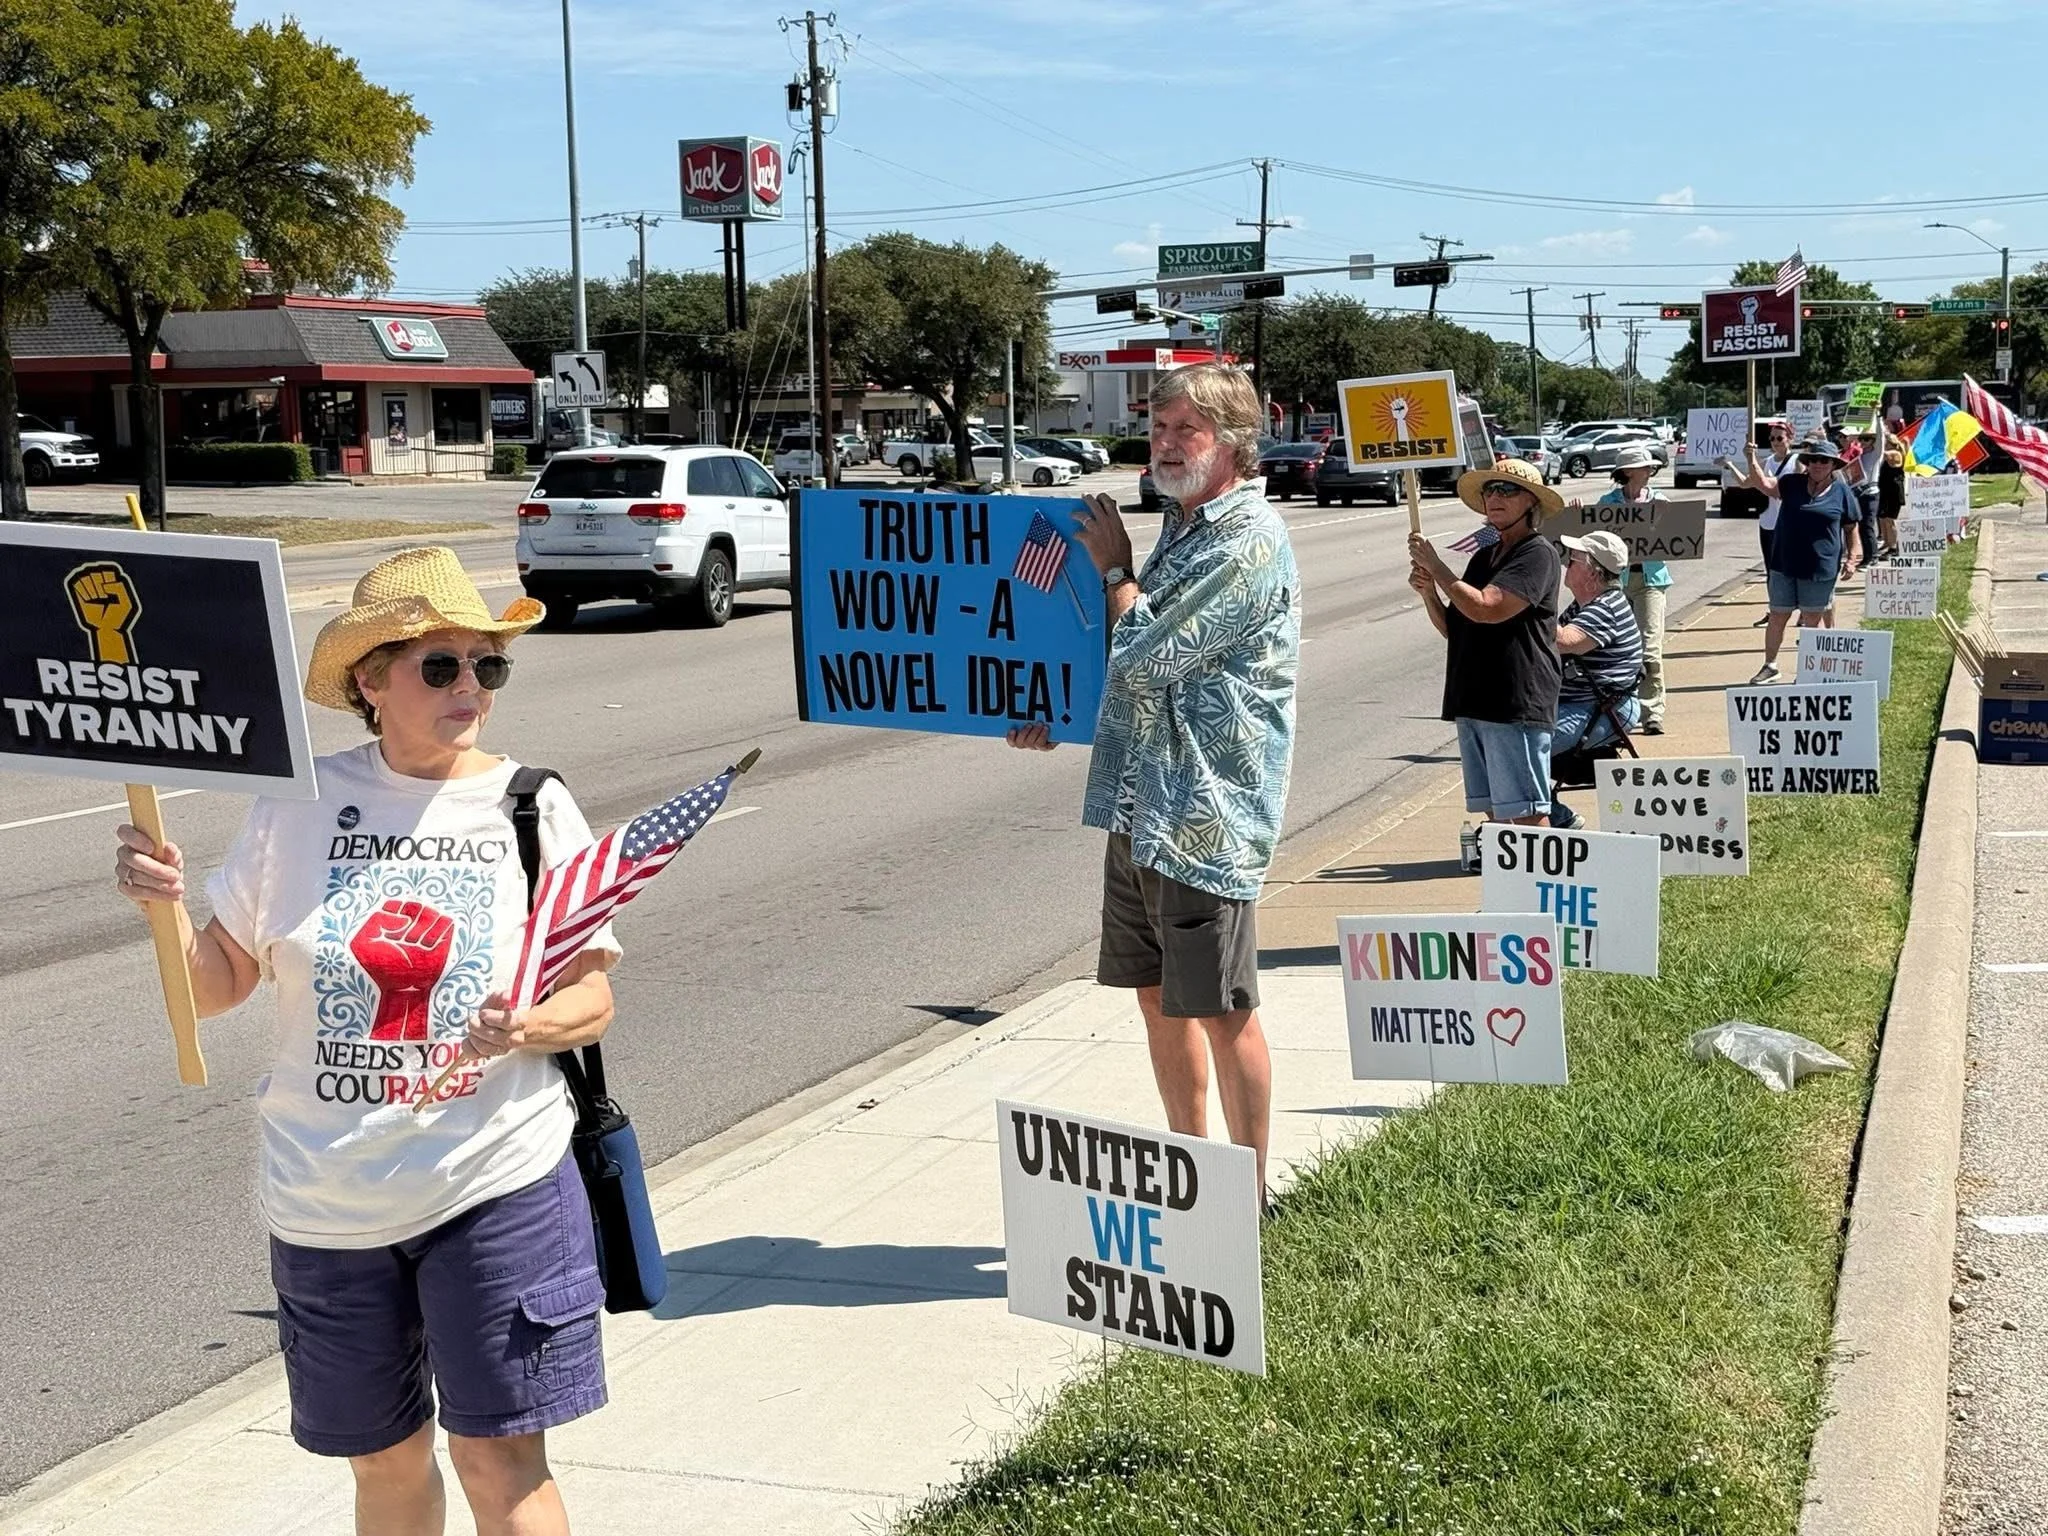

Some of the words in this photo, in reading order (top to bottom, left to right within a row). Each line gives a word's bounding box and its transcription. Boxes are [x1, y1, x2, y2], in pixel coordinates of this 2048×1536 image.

[685, 151, 743, 194] Jack
[753, 151, 783, 195] Jack
[689, 205, 700, 214] in
[701, 204, 720, 213] the
[721, 203, 742, 213] box
[1164, 245, 1253, 264] SPROUTS
[1939, 301, 1980, 309] Abrams
[1712, 335, 1789, 352] FASCISM
[1724, 323, 1777, 337] RESIST
[1059, 353, 1101, 369] Exxon
[490, 400, 526, 414] ROTHERS
[558, 395, 578, 404] ONLY
[583, 394, 603, 403] ONLY
[1707, 412, 1729, 433] NO
[1360, 438, 1447, 460] RESIST
[1695, 438, 1737, 457] KINGS
[859, 499, 990, 565] TRUTH
[1900, 521, 1917, 537] Say
[1922, 520, 1935, 533] No
[1551, 535, 1704, 559] DCRACY
[1902, 540, 1946, 553] VIOLENCE
[1870, 569, 1904, 585] HATE
[829, 569, 940, 636] WOW
[1879, 600, 1922, 616] GREAT.
[1816, 635, 1864, 654] VIOLENCE
[1805, 655, 1815, 670] IS
[1820, 656, 1838, 673] NOT
[1842, 659, 1863, 676] THE
[36, 658, 200, 706] RESIST
[819, 651, 947, 713] NOVEL
[967, 655, 1072, 726] IDEA!
[1734, 695, 1852, 722] VIOLENCE
[3, 697, 250, 755] TYRANNY
[1759, 729, 1781, 754] IS
[1794, 730, 1843, 756] NOT
[1611, 767, 1710, 787] PEACE
[1745, 767, 1774, 793] HE
[1781, 767, 1880, 794] ANSWER
[1634, 797, 1708, 817] LOVE
[328, 834, 512, 864] DEMOCRACY
[1497, 830, 1589, 877] STOP
[1660, 832, 1743, 860] DNESS
[1536, 881, 1598, 927] THE
[1347, 931, 1553, 986] KINDNESS
[1563, 927, 1593, 968] E!
[1370, 1006, 1475, 1046] MATTERS
[315, 1040, 404, 1070] NEEDS
[415, 1043, 491, 1069] YOU
[316, 1071, 483, 1105] COURAGE
[1011, 1110, 1198, 1211] UNITED
[1086, 1195, 1166, 1275] WE
[1066, 1255, 1235, 1358] STAND
